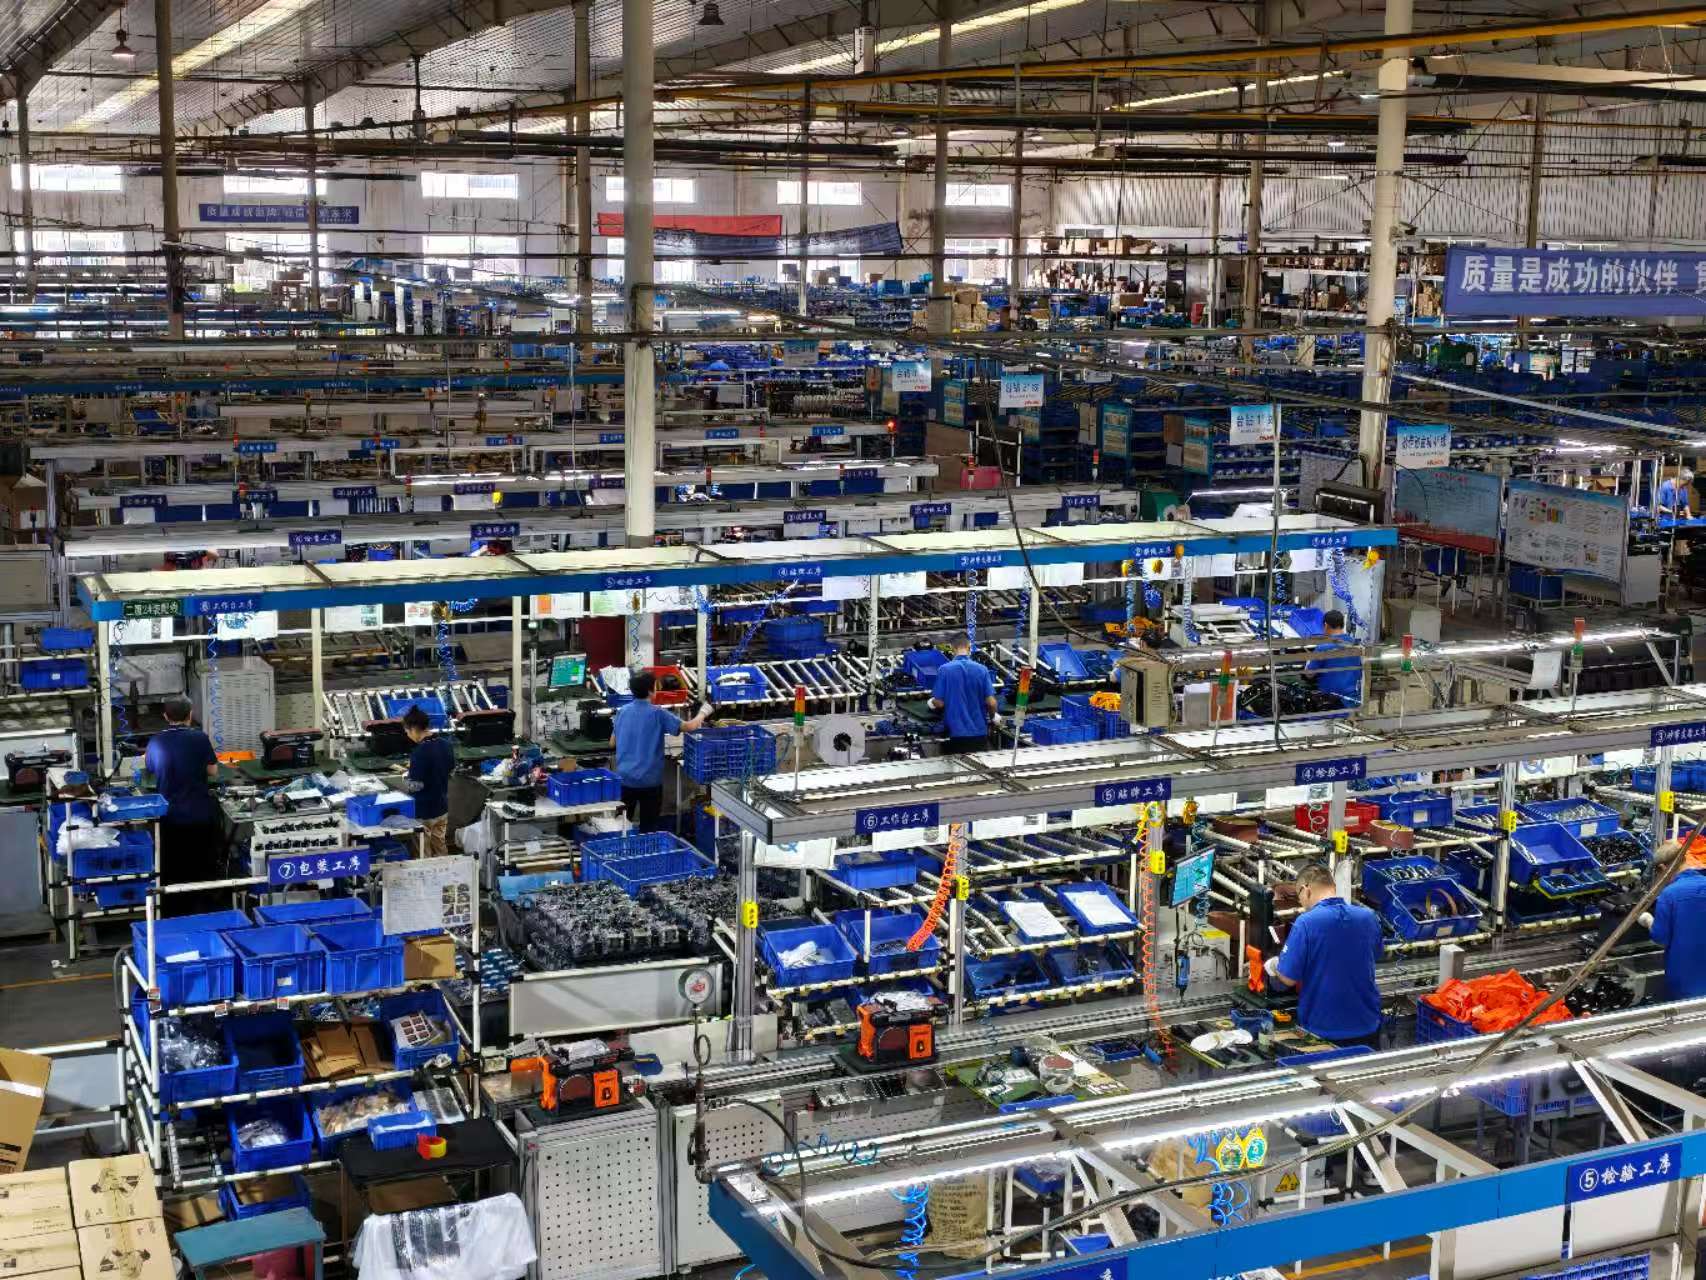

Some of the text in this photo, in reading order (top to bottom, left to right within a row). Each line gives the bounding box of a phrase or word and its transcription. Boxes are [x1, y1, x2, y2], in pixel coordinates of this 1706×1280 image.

[1460, 254, 1679, 296] 质量是成功的伙伴
